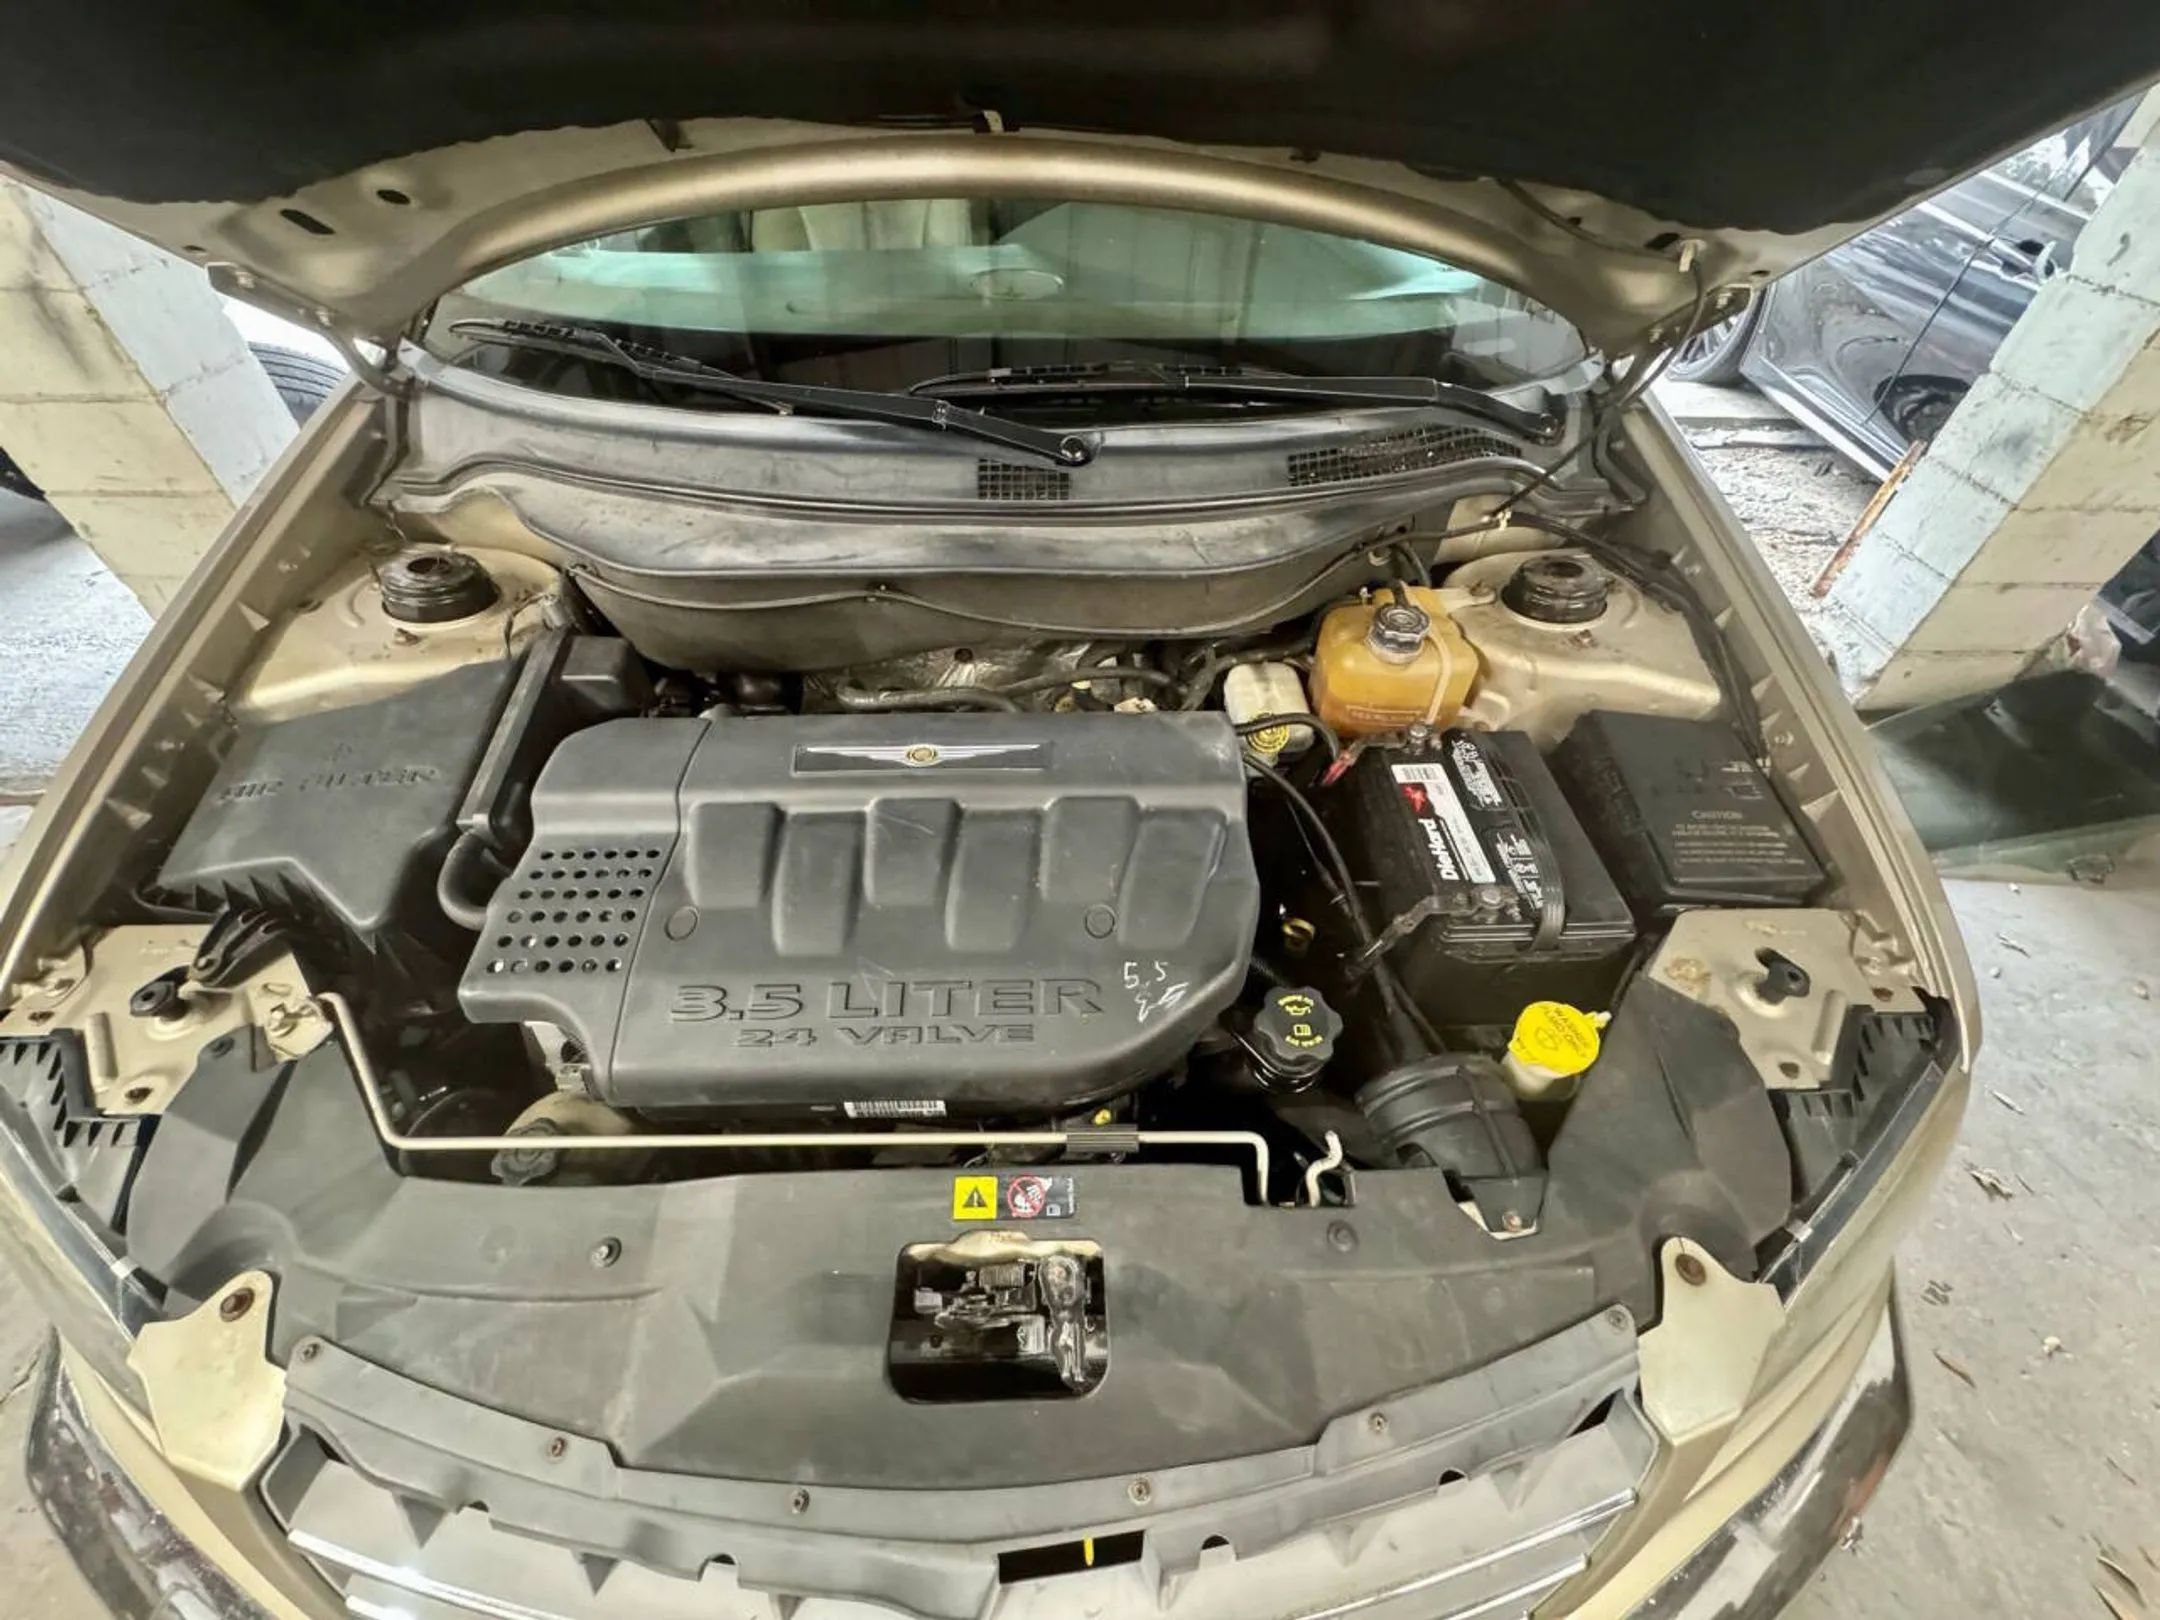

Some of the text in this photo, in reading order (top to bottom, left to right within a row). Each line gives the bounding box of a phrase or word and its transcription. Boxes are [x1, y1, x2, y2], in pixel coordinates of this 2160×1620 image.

[1418, 818, 1460, 880] DieHard
[671, 979, 1105, 1022] 3.5 LITER
[735, 1024, 1036, 1047] 24 VALVE
